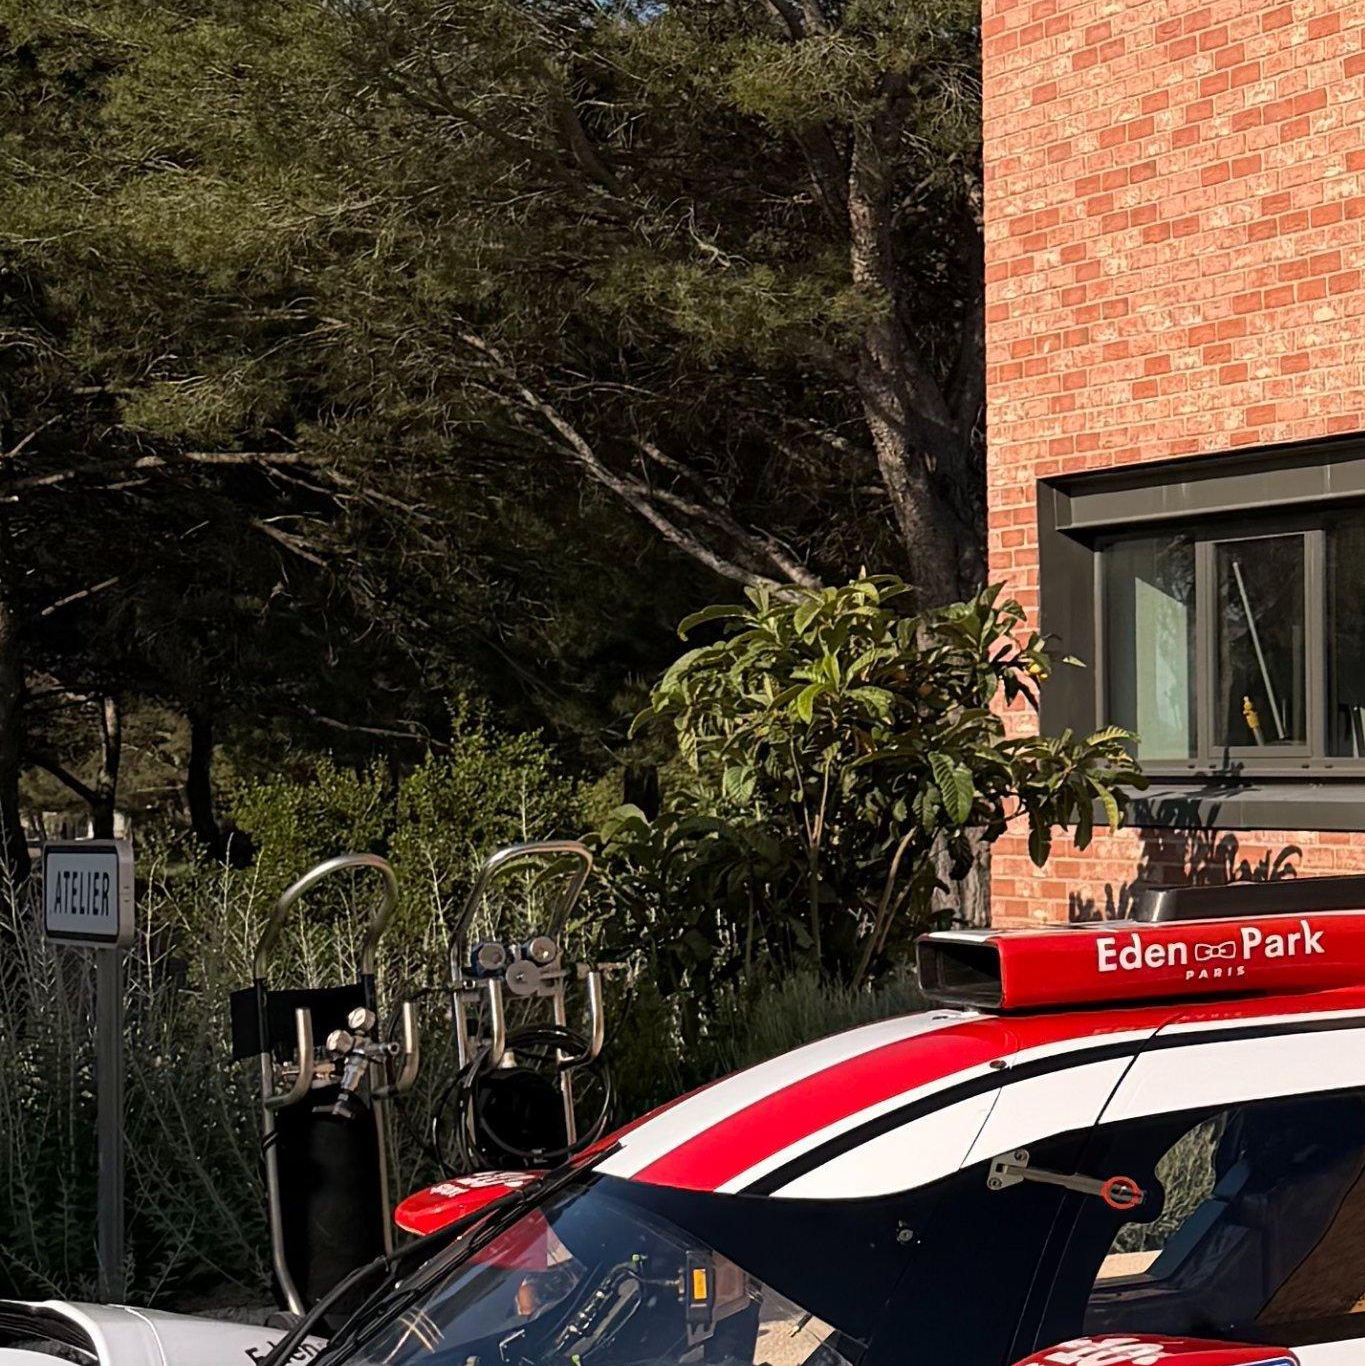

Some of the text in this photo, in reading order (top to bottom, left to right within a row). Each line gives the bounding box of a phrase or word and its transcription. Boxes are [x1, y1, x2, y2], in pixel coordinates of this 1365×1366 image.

[54, 871, 110, 916] ATELIER
[1096, 919, 1325, 974] Eden Park
[1184, 964, 1247, 982] PARIS
